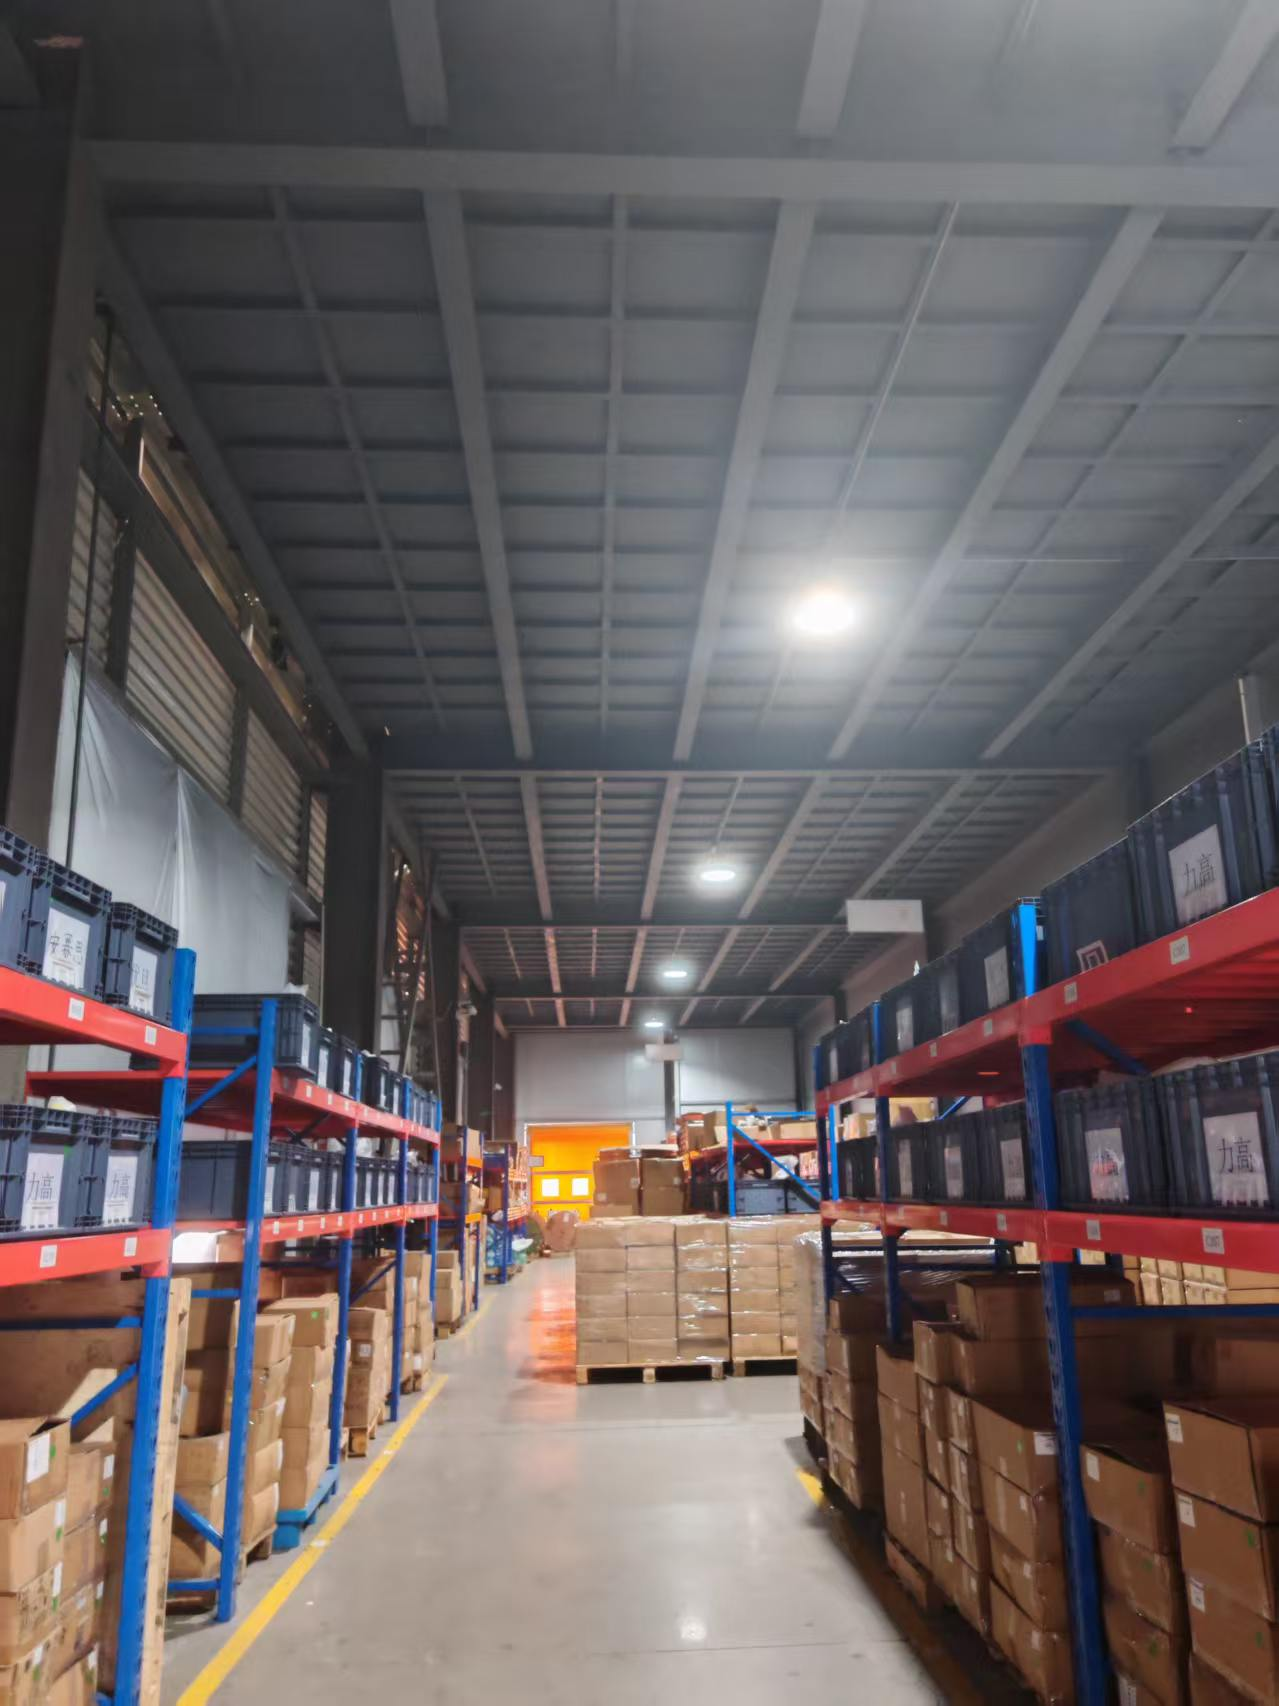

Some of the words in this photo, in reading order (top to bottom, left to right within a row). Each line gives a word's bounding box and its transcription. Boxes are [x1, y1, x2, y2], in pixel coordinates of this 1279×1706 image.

[1183, 853, 1216, 896] 力高
[1217, 1137, 1256, 1174] 力高
[27, 1171, 54, 1201] 力高
